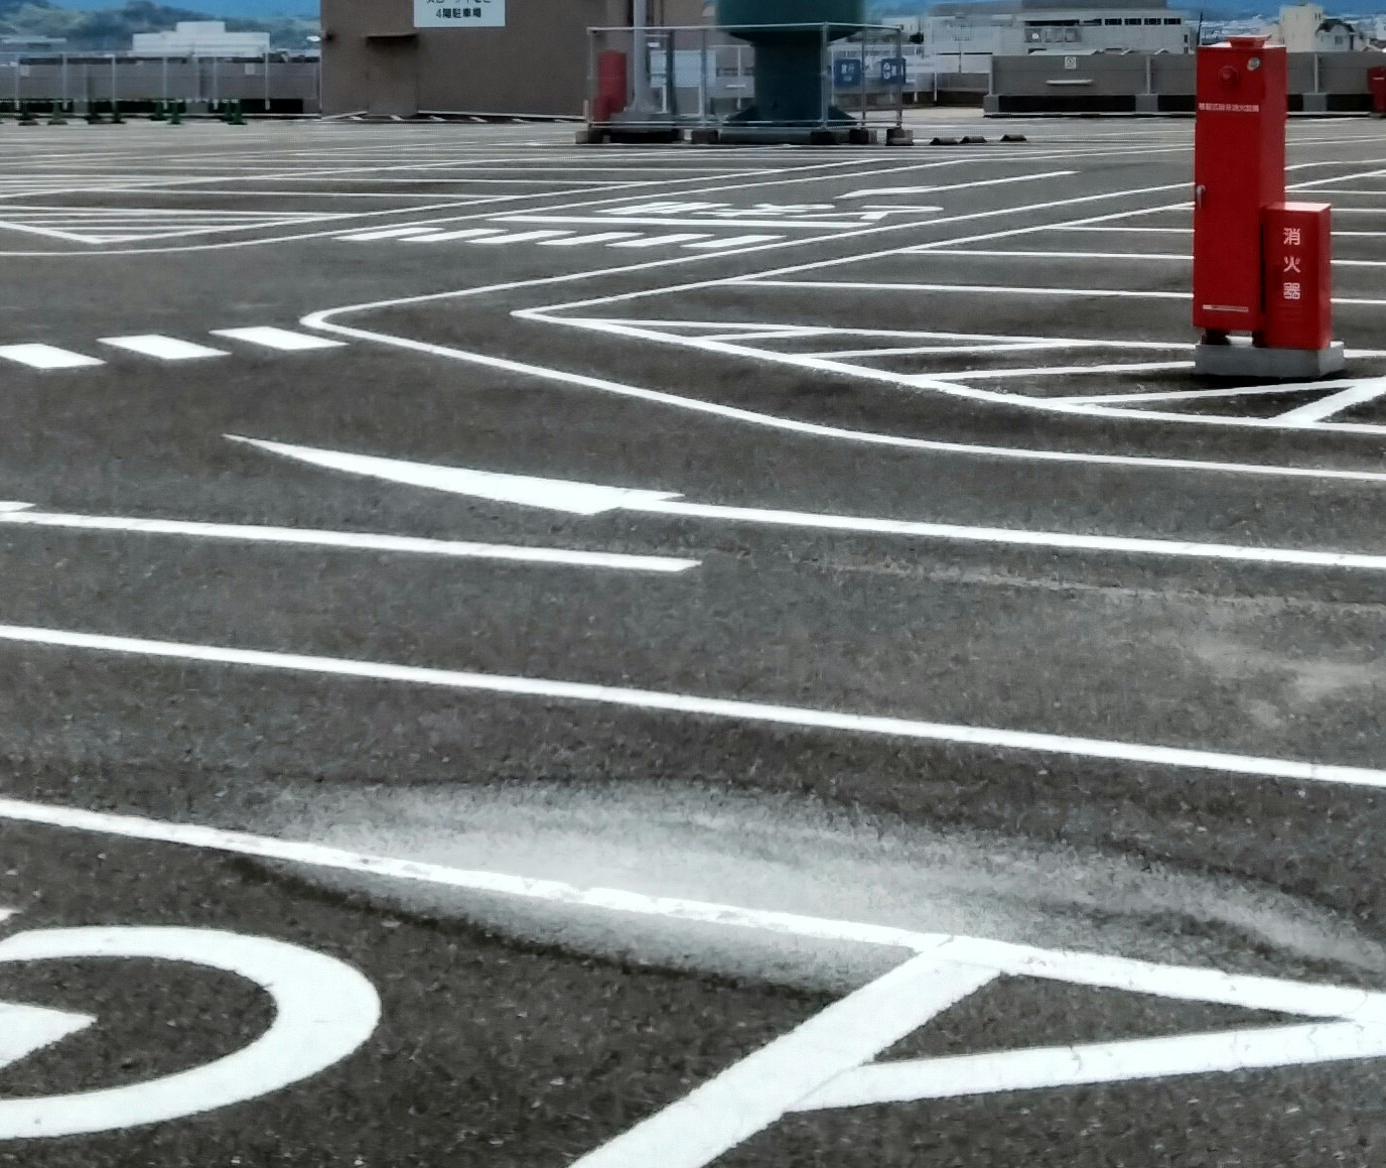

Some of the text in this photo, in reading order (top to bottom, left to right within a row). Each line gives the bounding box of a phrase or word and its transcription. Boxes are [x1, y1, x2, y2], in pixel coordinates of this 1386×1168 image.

[435, 7, 481, 18] 4階駐車場
[1283, 227, 1301, 300] 消火器
